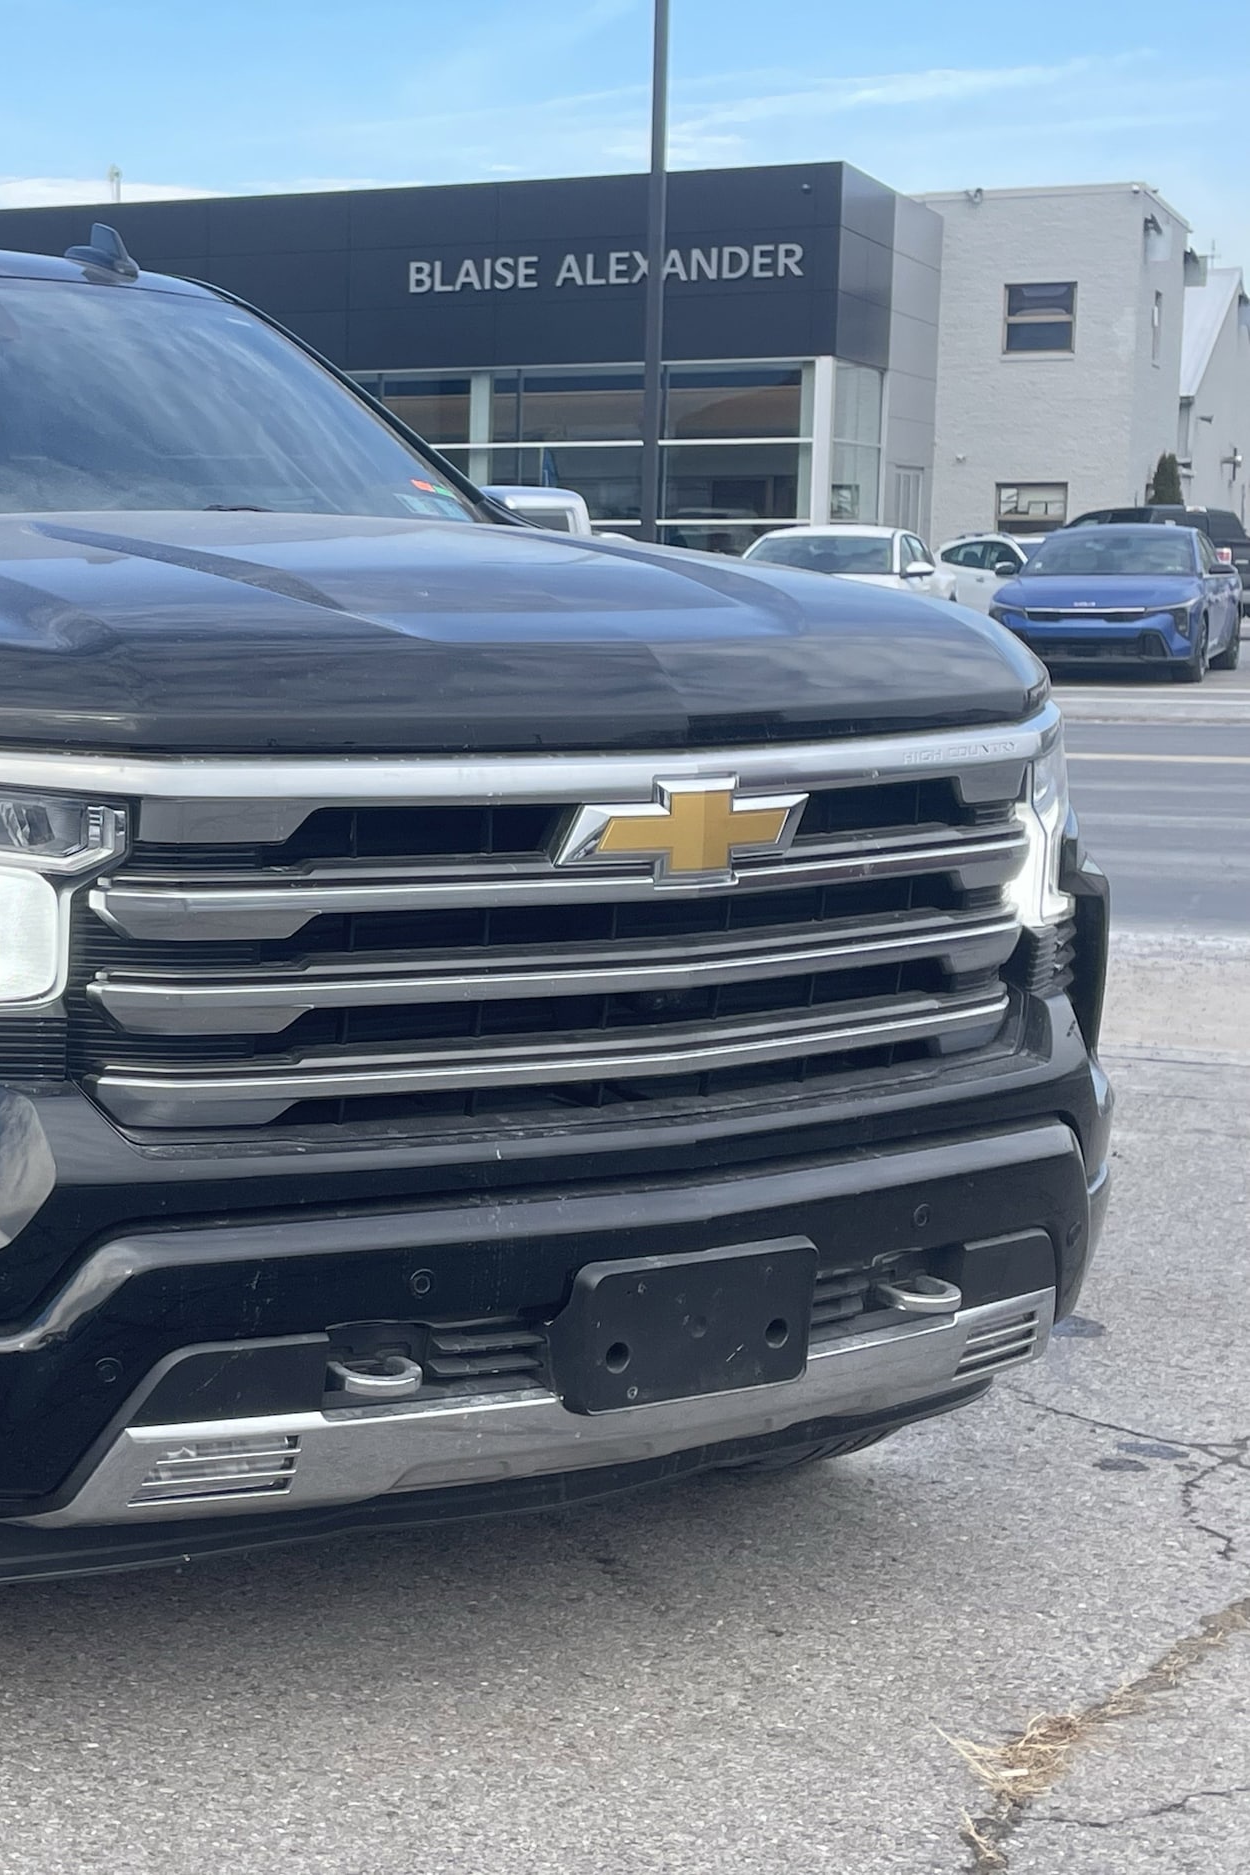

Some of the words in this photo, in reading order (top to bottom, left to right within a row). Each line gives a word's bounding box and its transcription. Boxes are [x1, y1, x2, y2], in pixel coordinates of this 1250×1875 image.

[408, 256, 539, 294] BLAISE
[555, 243, 805, 288] ALEXANDER
[902, 749, 944, 765] HIGH
[948, 741, 1018, 759] COUNTRY
